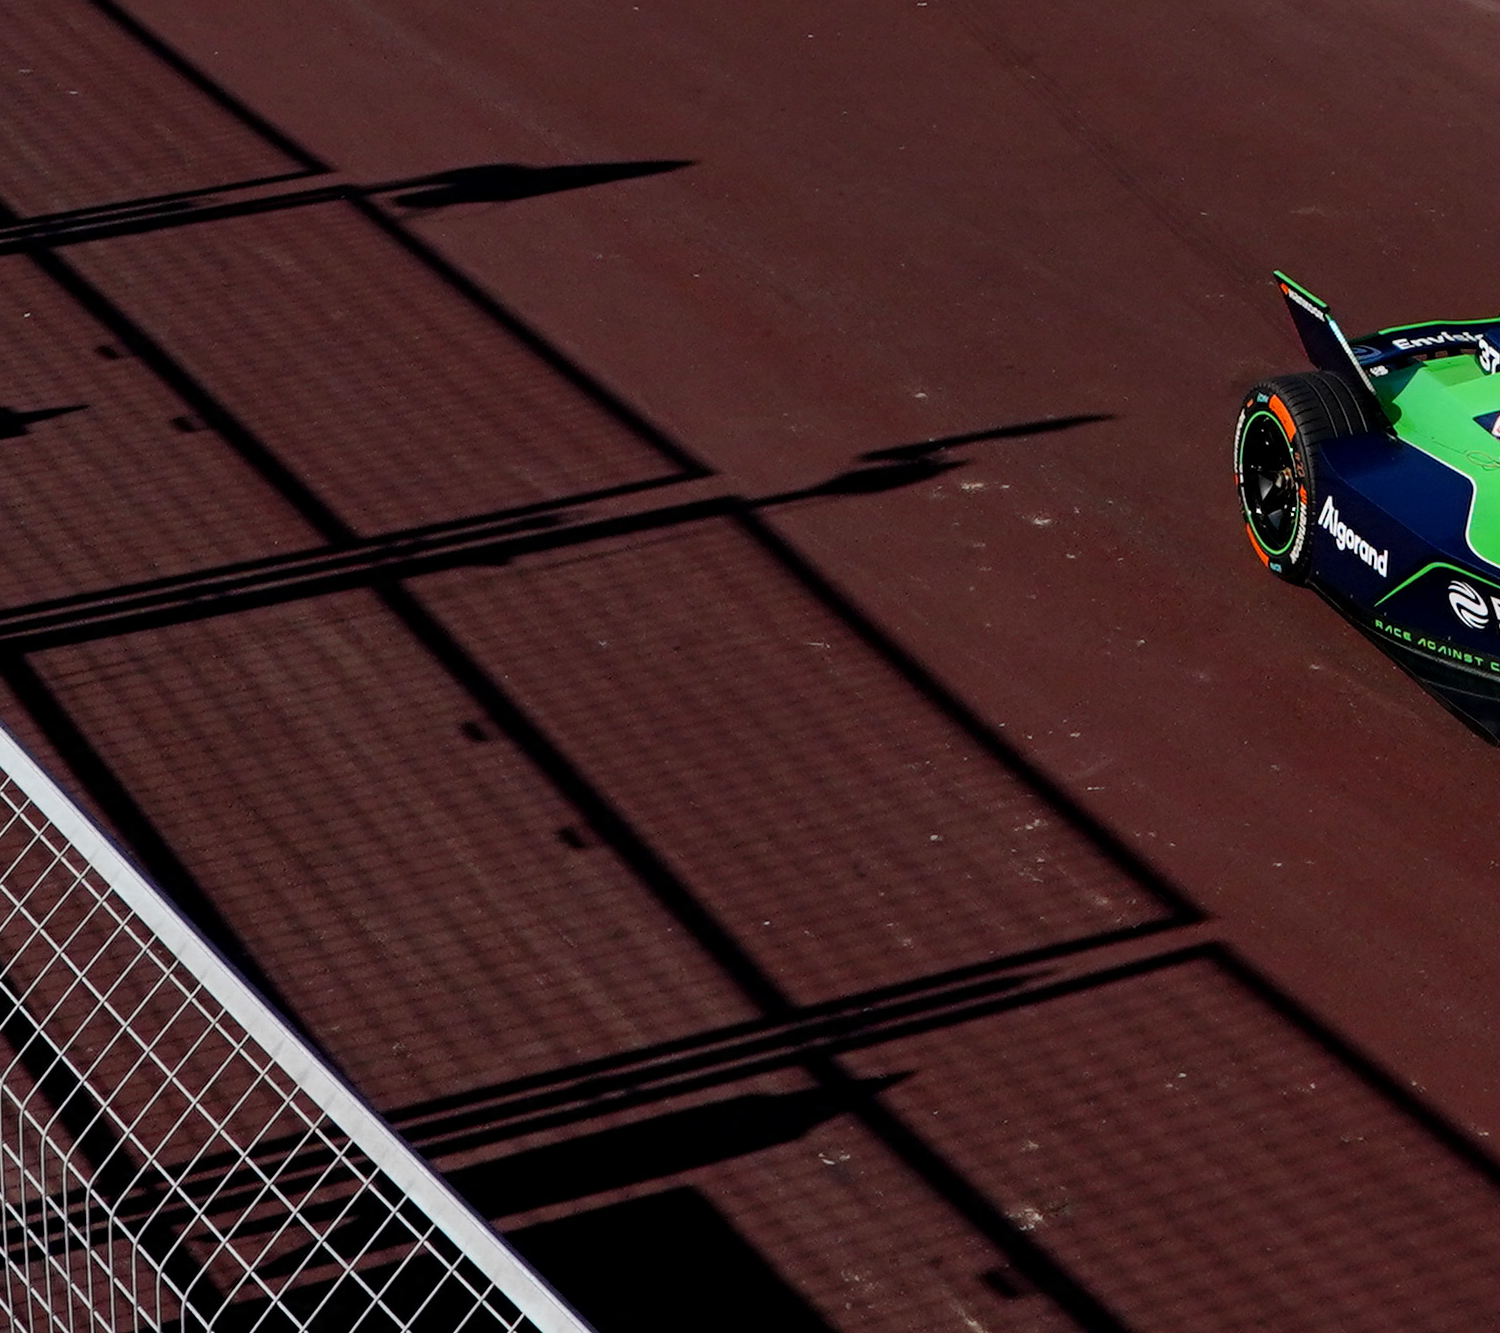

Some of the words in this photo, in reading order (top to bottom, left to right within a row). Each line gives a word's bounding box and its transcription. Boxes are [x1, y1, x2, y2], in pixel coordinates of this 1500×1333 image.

[1478, 338, 1500, 375] 37
[1318, 495, 1390, 578] Algorand
[1374, 619, 1412, 643] RACE
[1417, 637, 1485, 667] AGAINST
